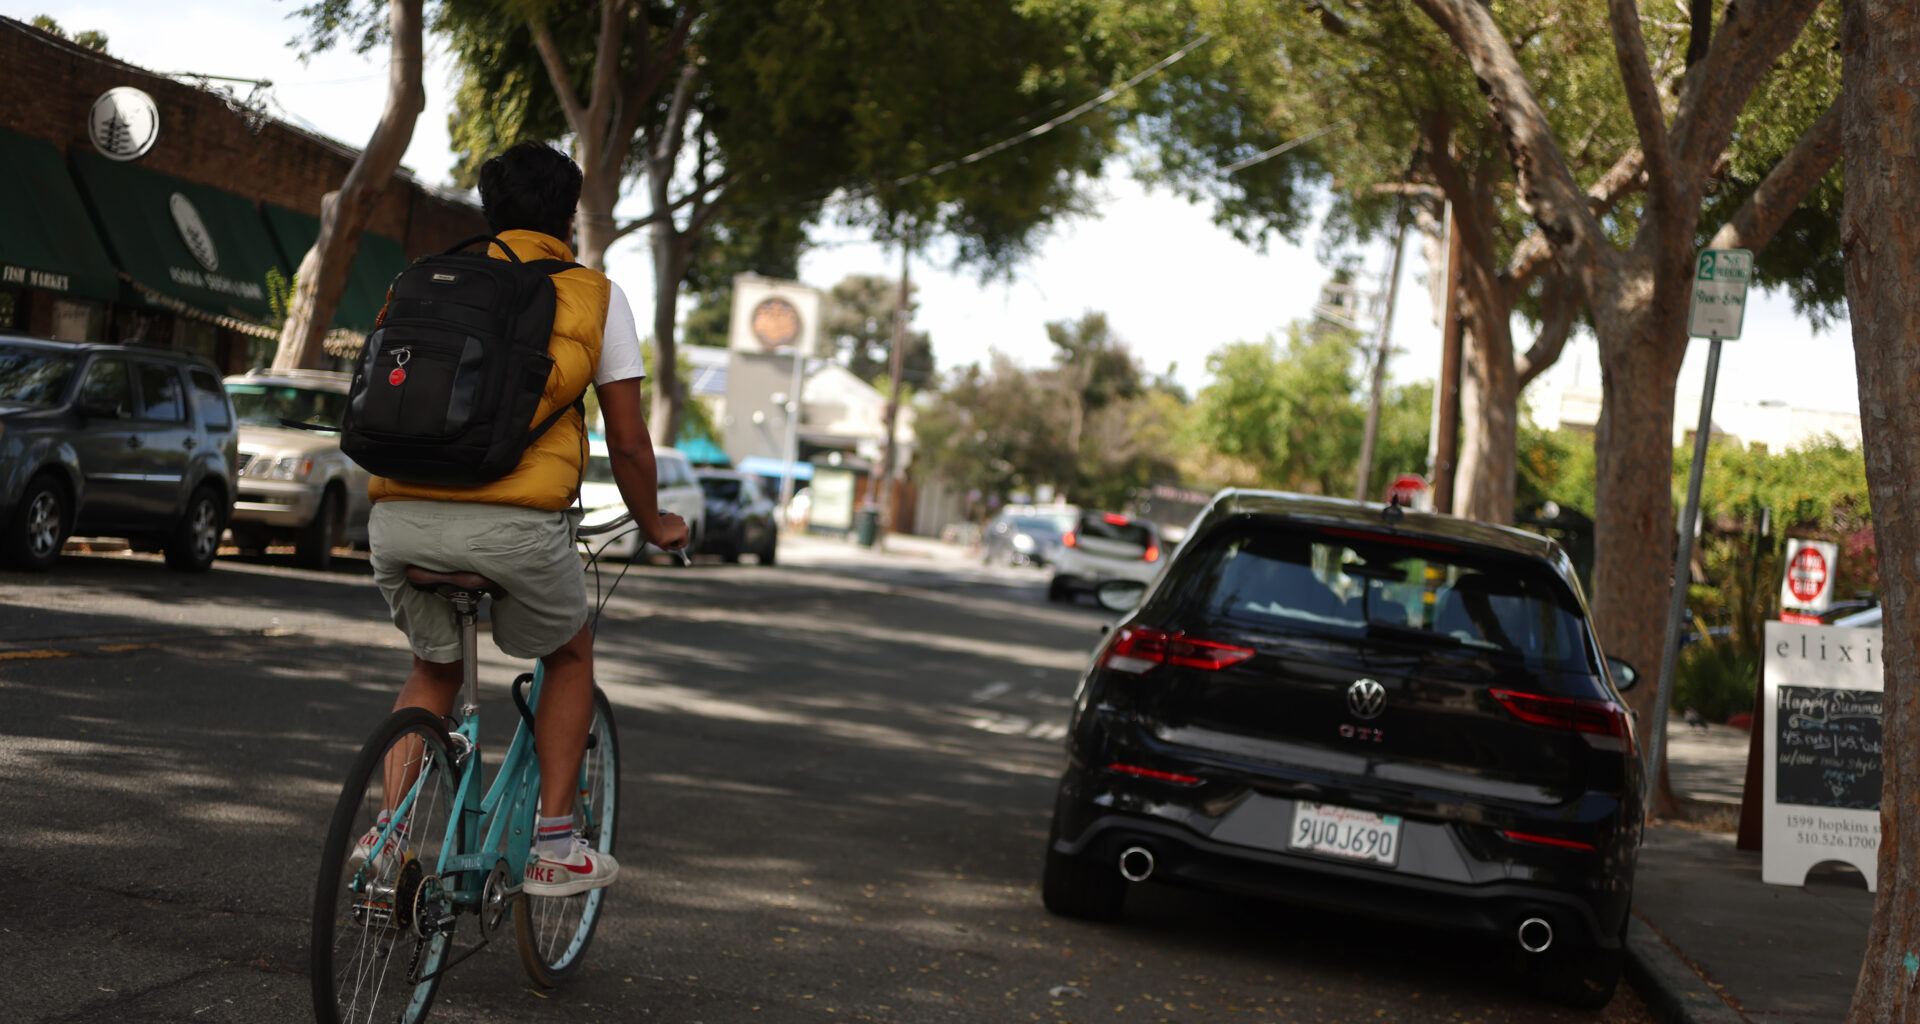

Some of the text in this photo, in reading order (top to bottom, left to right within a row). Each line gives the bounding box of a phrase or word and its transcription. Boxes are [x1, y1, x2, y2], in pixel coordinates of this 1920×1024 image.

[1700, 255, 1713, 278] 2
[3, 265, 69, 292] FISH MARKET
[1776, 633, 1872, 664] elixi
[1779, 687, 1828, 723] Happy
[1340, 724, 1383, 742] GTI
[1787, 814, 1814, 828] 1599
[1818, 817, 1869, 833] hopkins
[1298, 818, 1392, 857] 9UQJ690
[1797, 830, 1876, 849] 510.526.1700
[526, 865, 555, 883] NIKE
